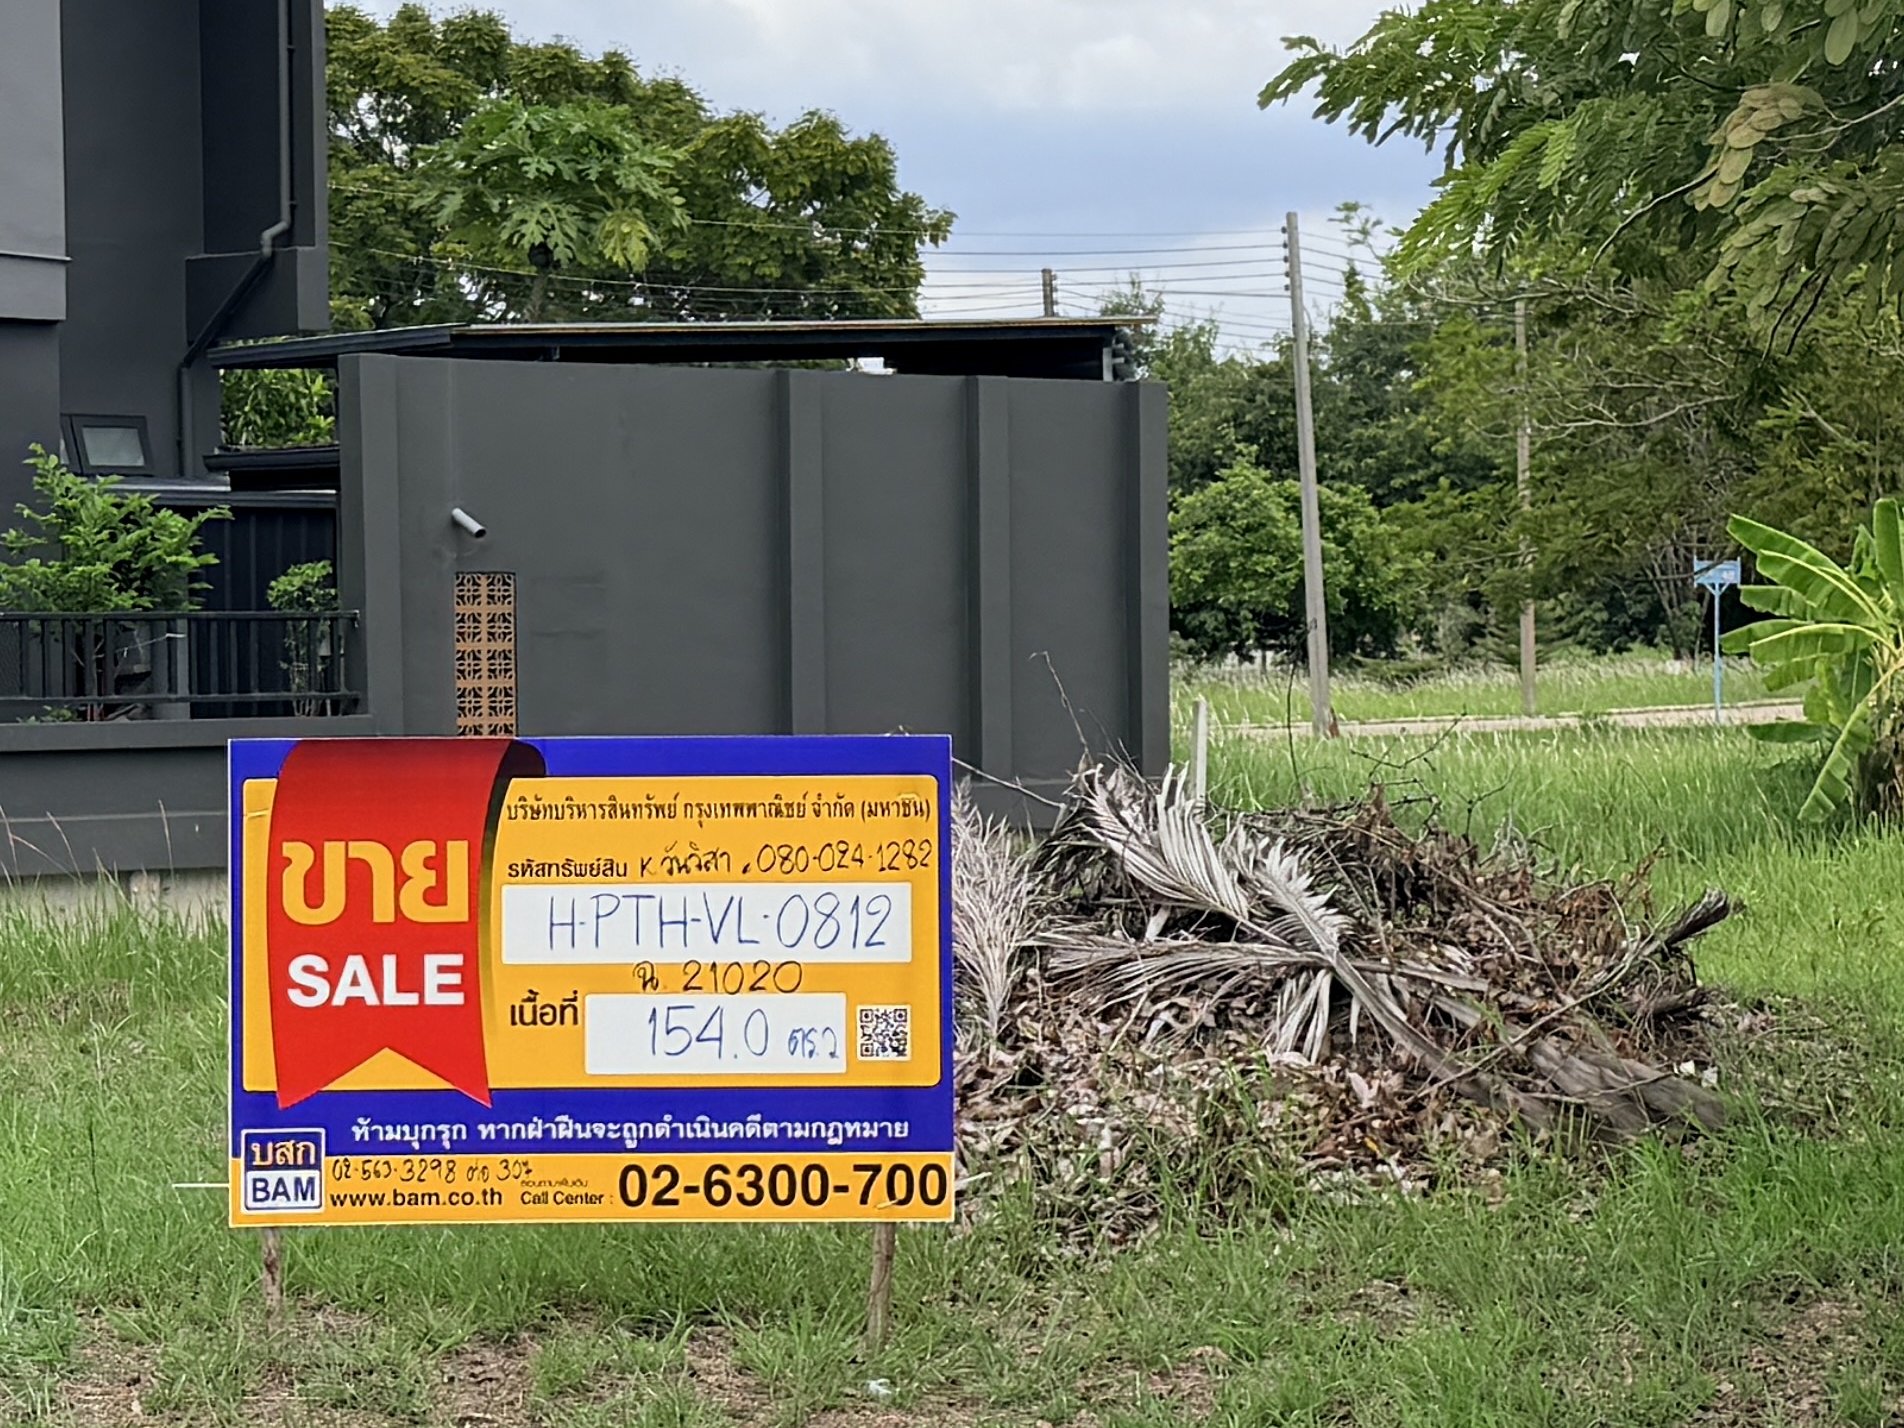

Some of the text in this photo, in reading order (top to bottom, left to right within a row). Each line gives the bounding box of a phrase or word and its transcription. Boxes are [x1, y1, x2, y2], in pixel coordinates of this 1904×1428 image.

[507, 791, 931, 828] บริษัทบริหารสินทรัพย์ กรุงเทพพาณิชย์ จำกัด (มหาชน)
[282, 840, 470, 925] ขาย
[507, 857, 628, 878] รหัสทรัพย์สิน
[287, 954, 465, 1008] SALE
[682, 959, 803, 995] 21020
[509, 989, 580, 1027] เนื้อที่
[648, 1004, 770, 1060] 154.0
[351, 1116, 468, 1150] ห้ามบุกรุก
[250, 1139, 317, 1167] บสก
[251, 1175, 317, 1204] BAM
[329, 1187, 503, 1208] www.bam.co.th
[519, 1190, 549, 1205] Call
[618, 1162, 948, 1208] 02-6300-700
